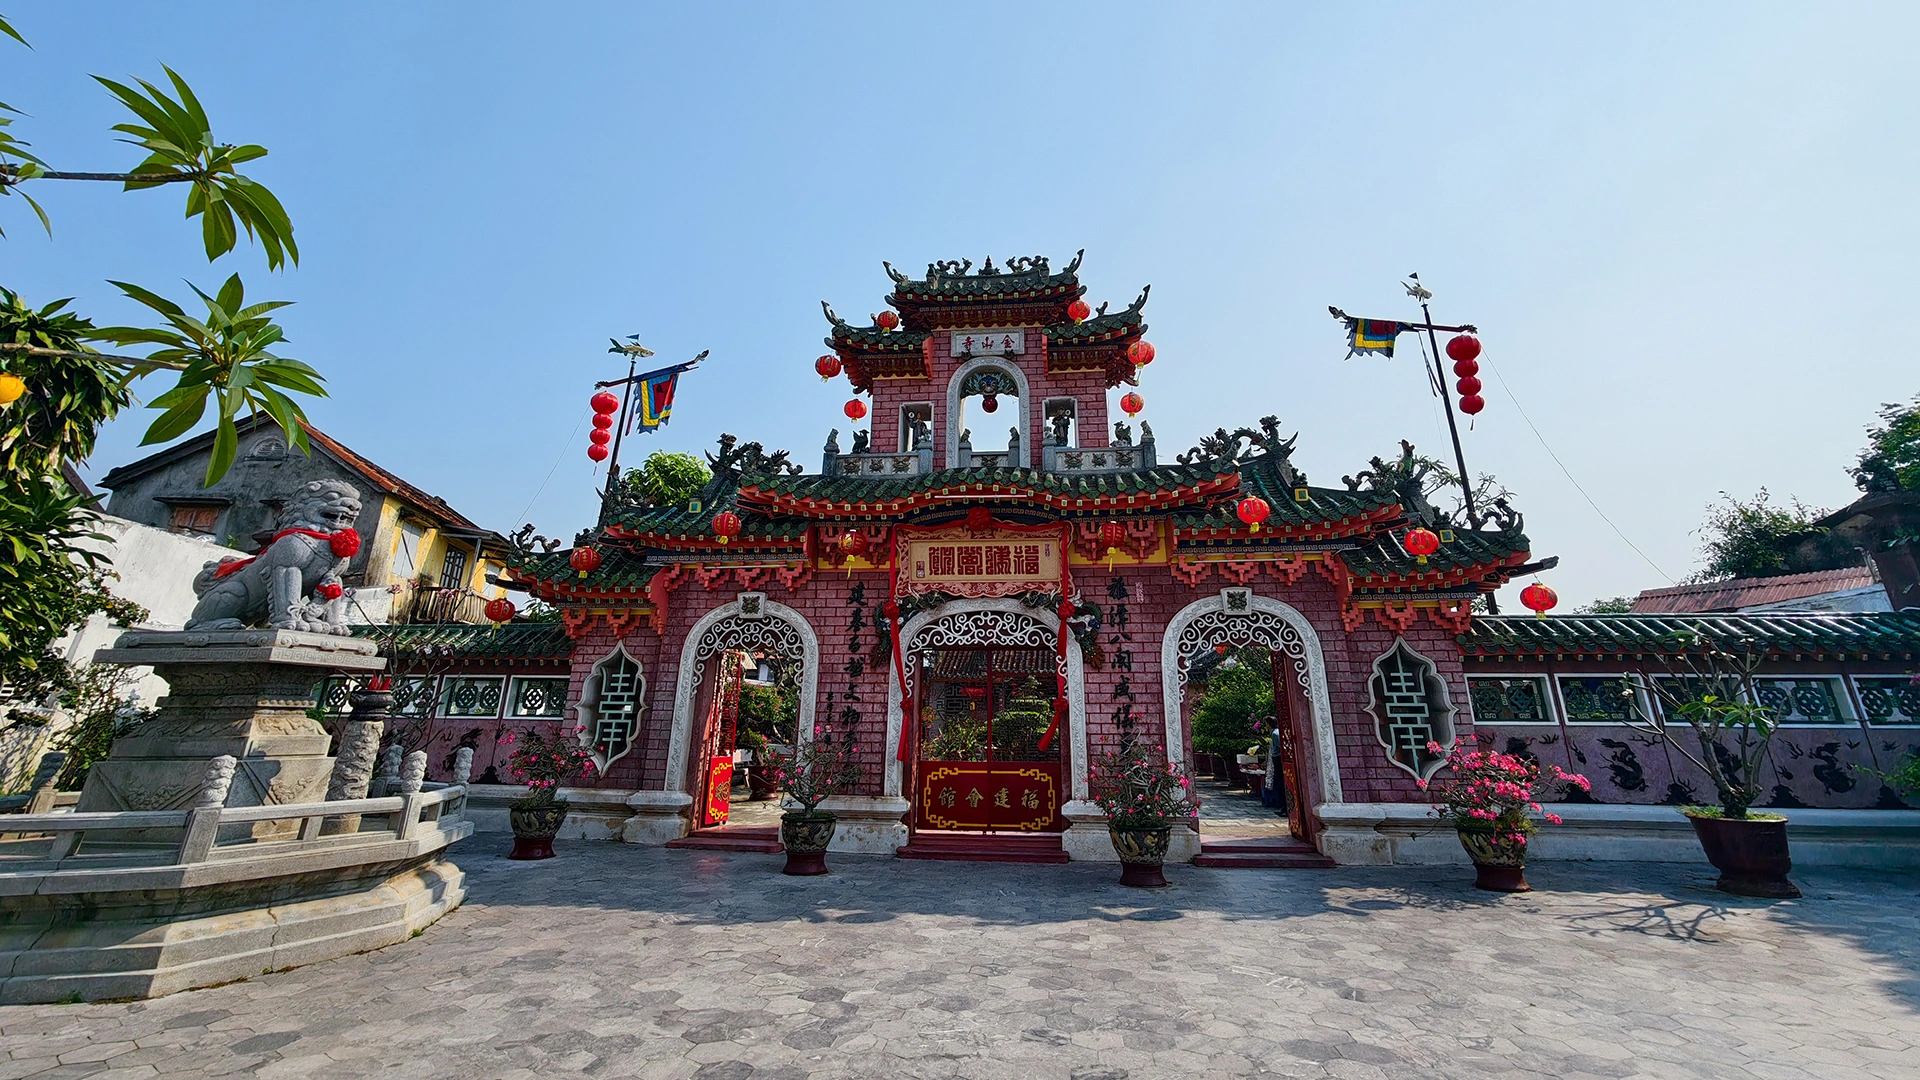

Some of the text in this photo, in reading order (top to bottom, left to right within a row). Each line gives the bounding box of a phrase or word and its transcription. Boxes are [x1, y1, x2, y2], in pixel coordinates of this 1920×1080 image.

[961, 334, 1016, 350] 金山寺
[938, 786, 1040, 810] 福建會館
